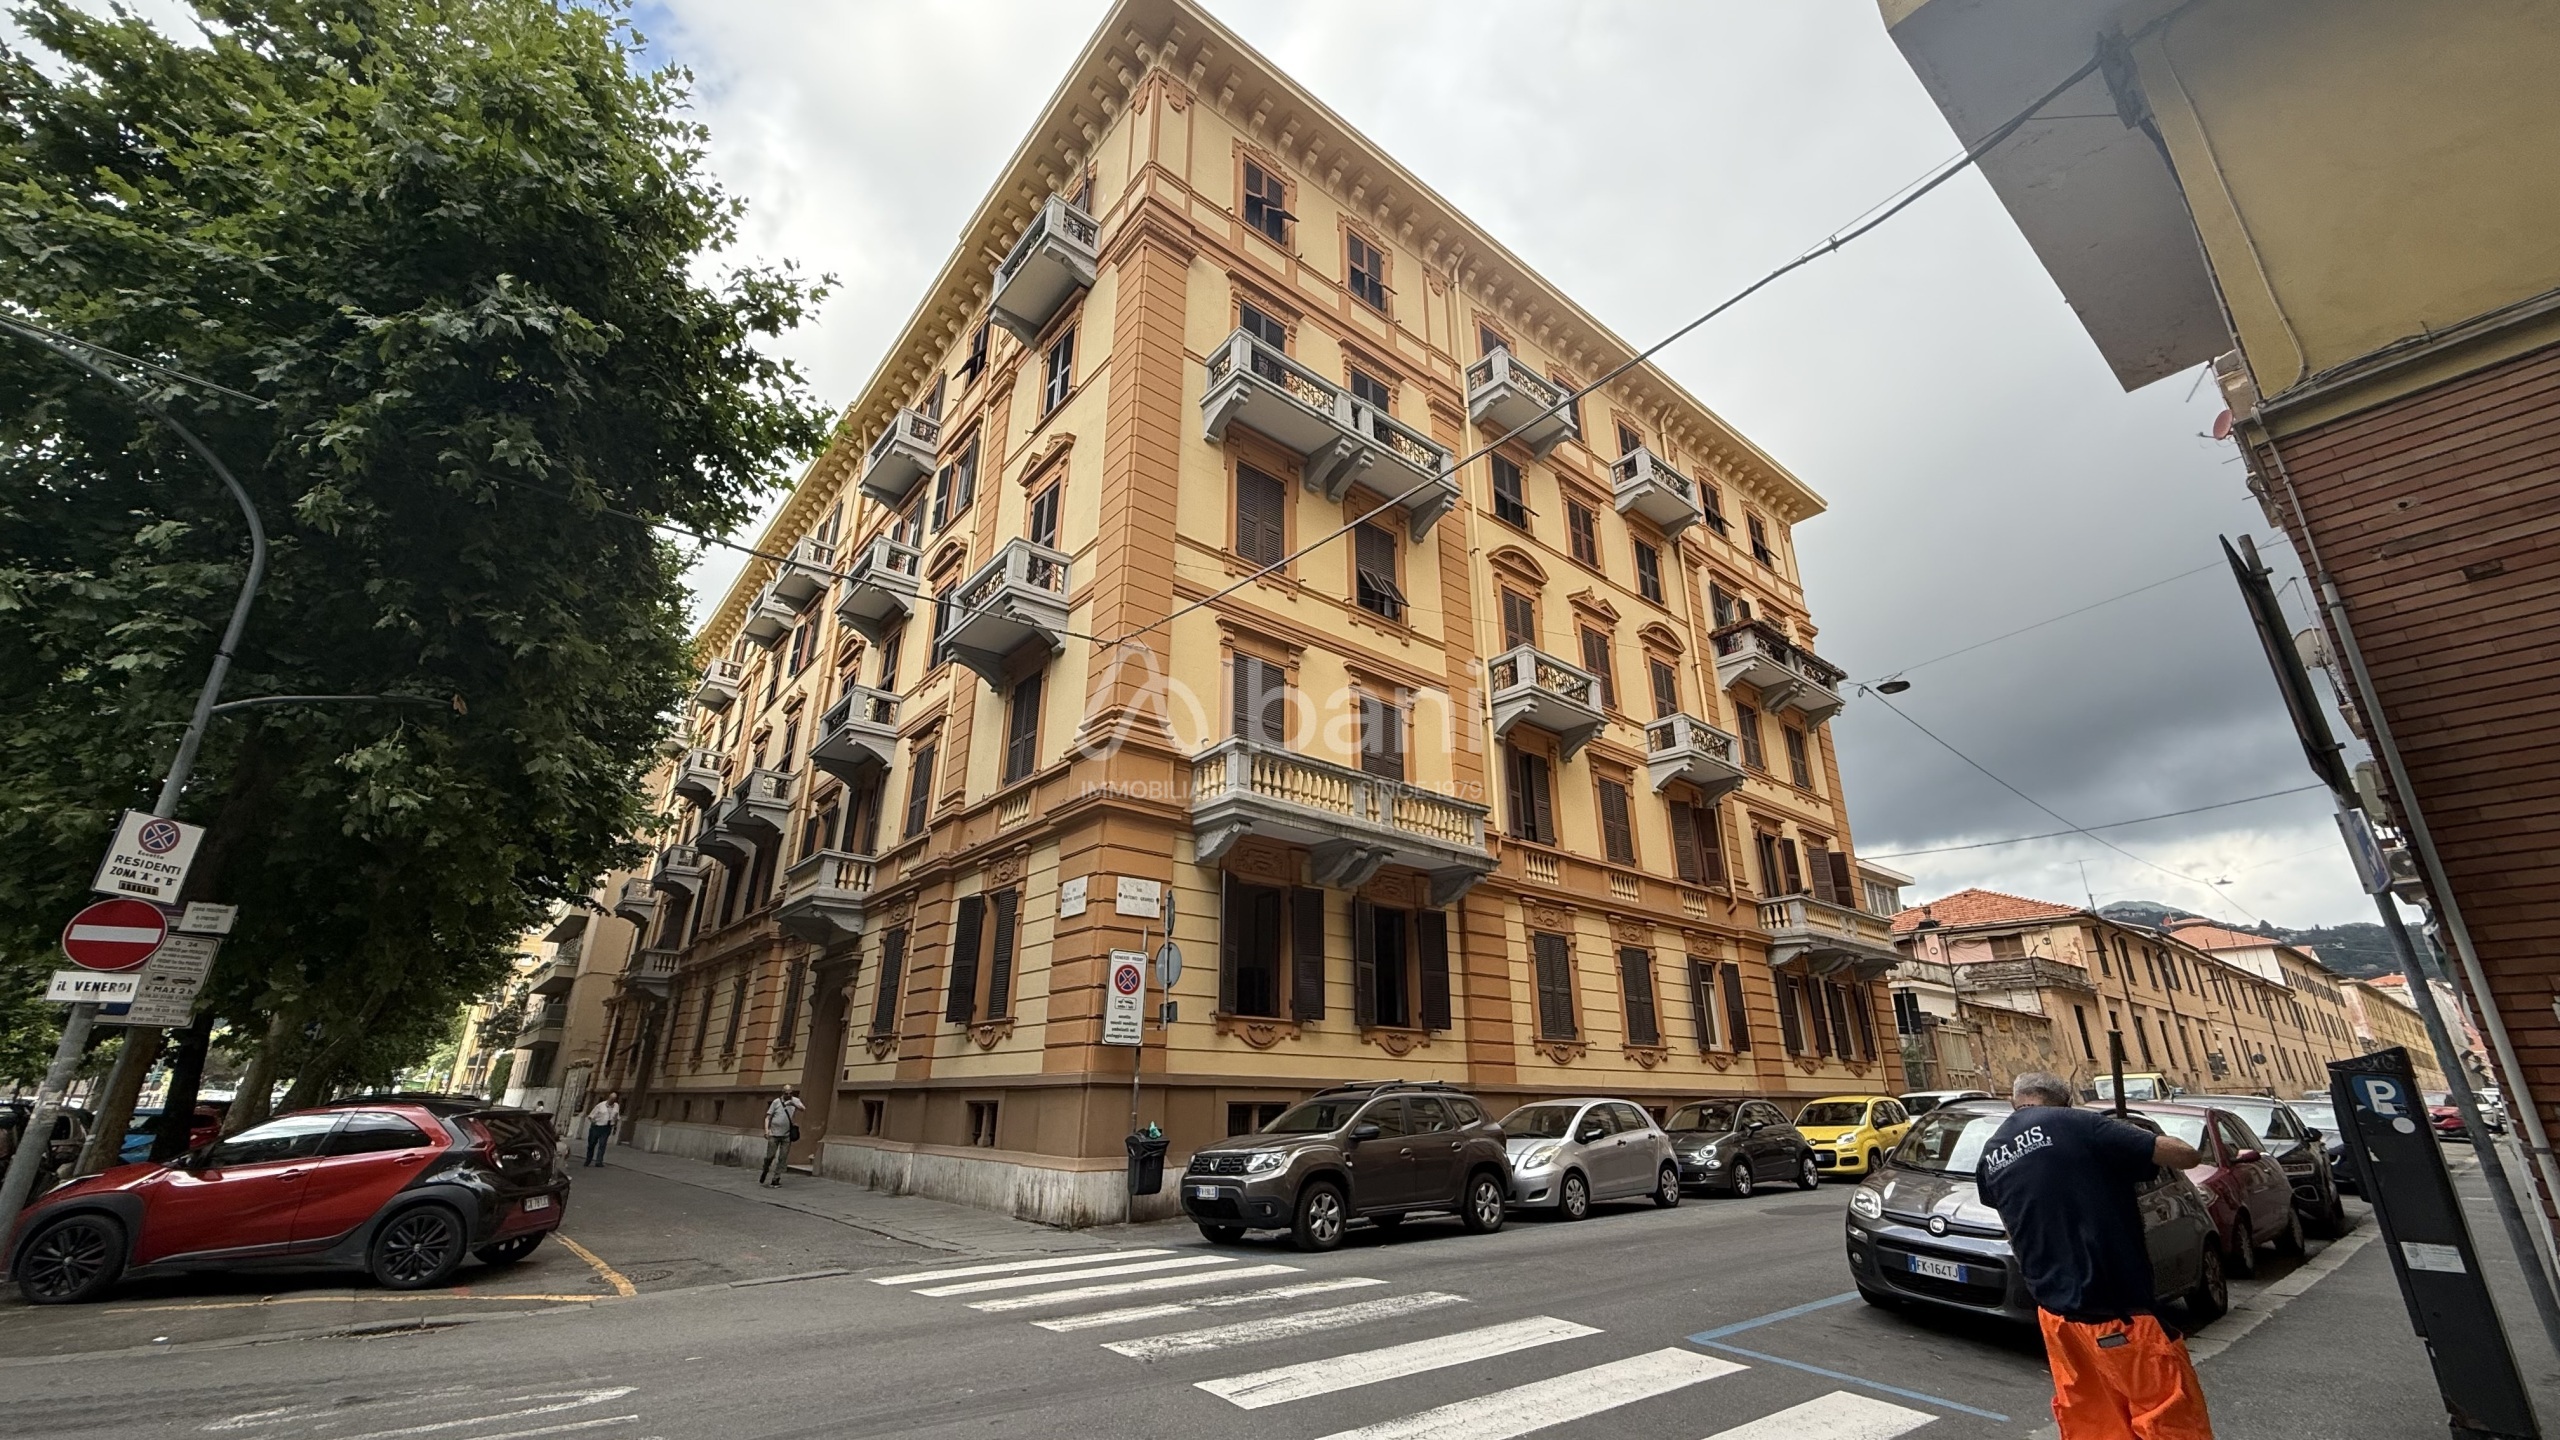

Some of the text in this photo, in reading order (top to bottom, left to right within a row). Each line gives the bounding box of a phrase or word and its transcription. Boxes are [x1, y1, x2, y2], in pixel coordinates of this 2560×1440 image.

[109, 866, 137, 879] ZONA
[114, 854, 182, 876] RESIDENTI
[75, 981, 132, 993] VENERDI
[153, 986, 176, 994] MAX
[2365, 1080, 2397, 1114] P
[1985, 1125, 2052, 1170] MA.RIS.
[1988, 1140, 2054, 1176] COOPERATIVA SOCIALE
